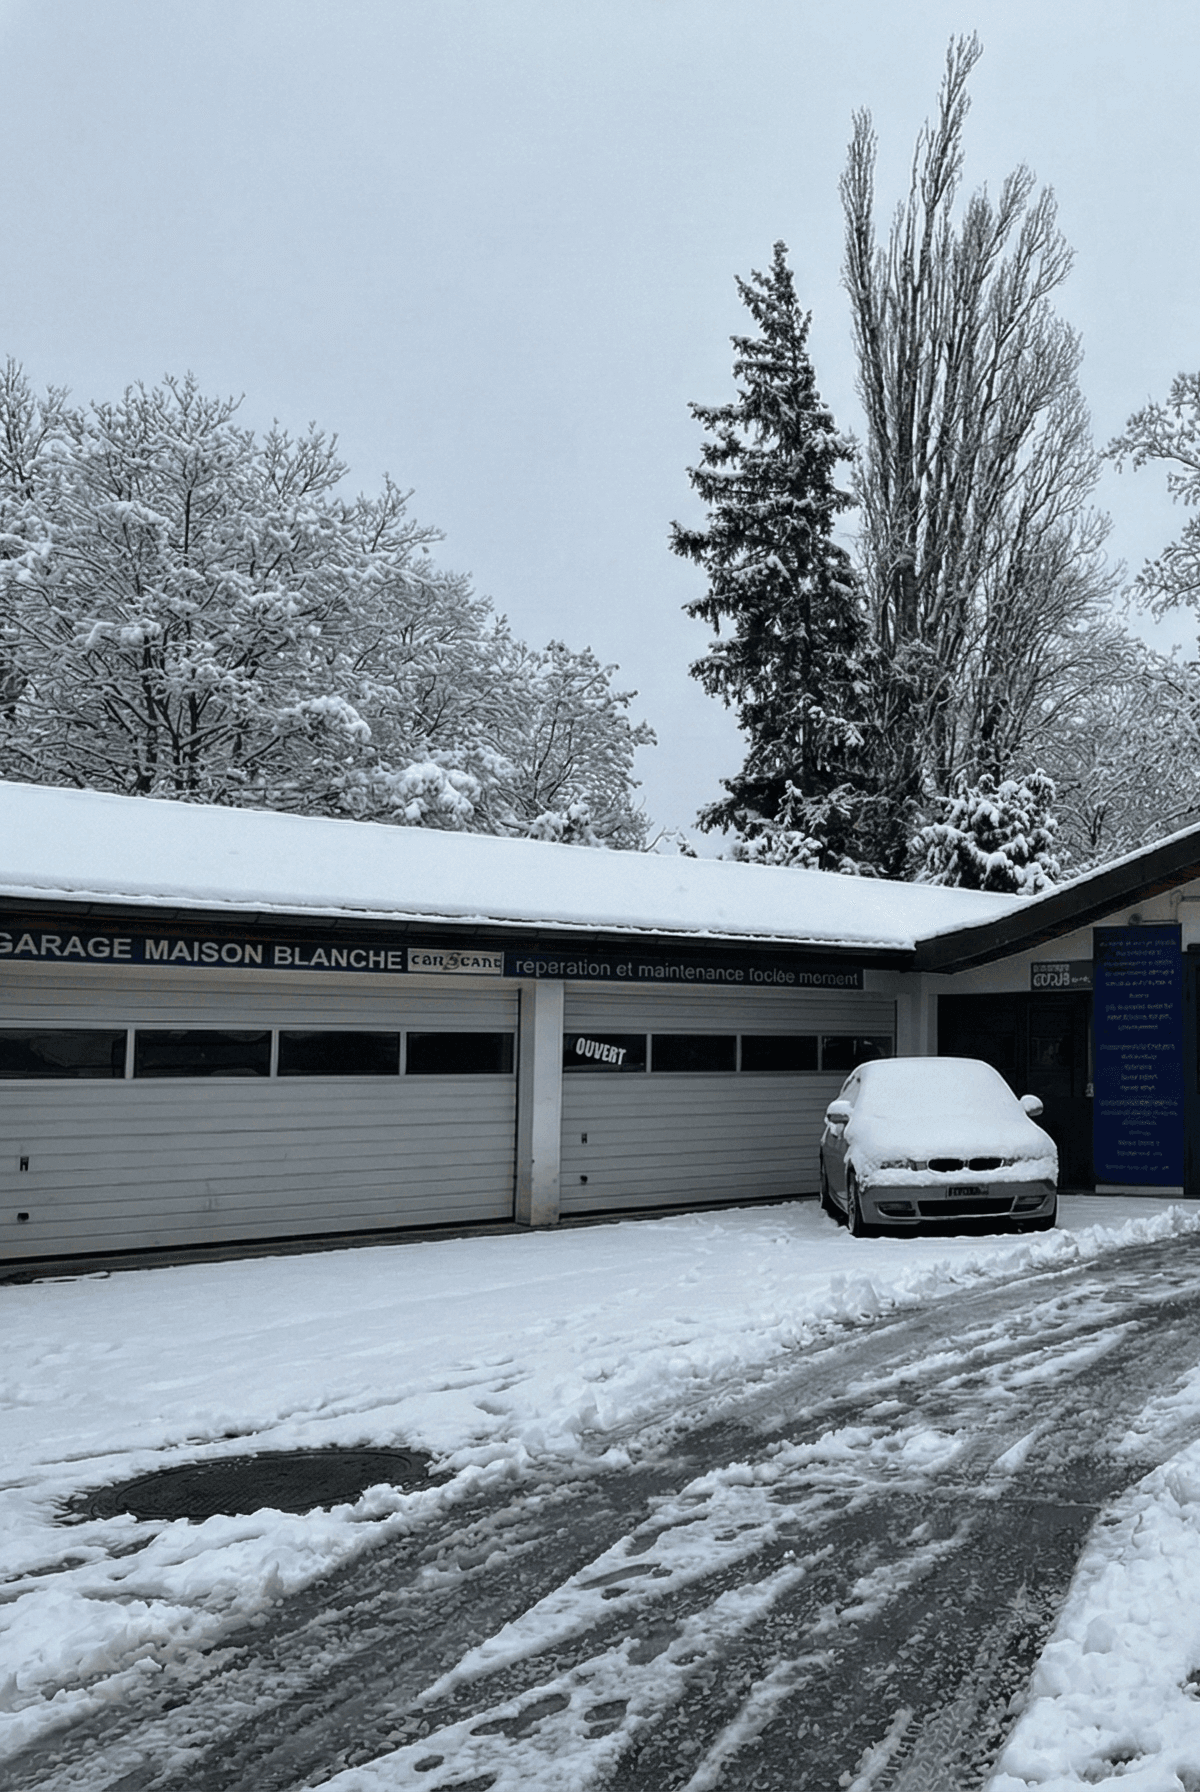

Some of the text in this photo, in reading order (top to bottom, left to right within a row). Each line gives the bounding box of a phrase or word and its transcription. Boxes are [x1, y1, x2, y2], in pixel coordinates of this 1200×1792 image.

[0, 932, 132, 959] GARAGE
[144, 938, 263, 965] MAISON
[273, 945, 403, 970] BLANCHE
[616, 961, 633, 977] et
[638, 962, 745, 982] maintenance
[575, 1037, 627, 1066] OUVERT
